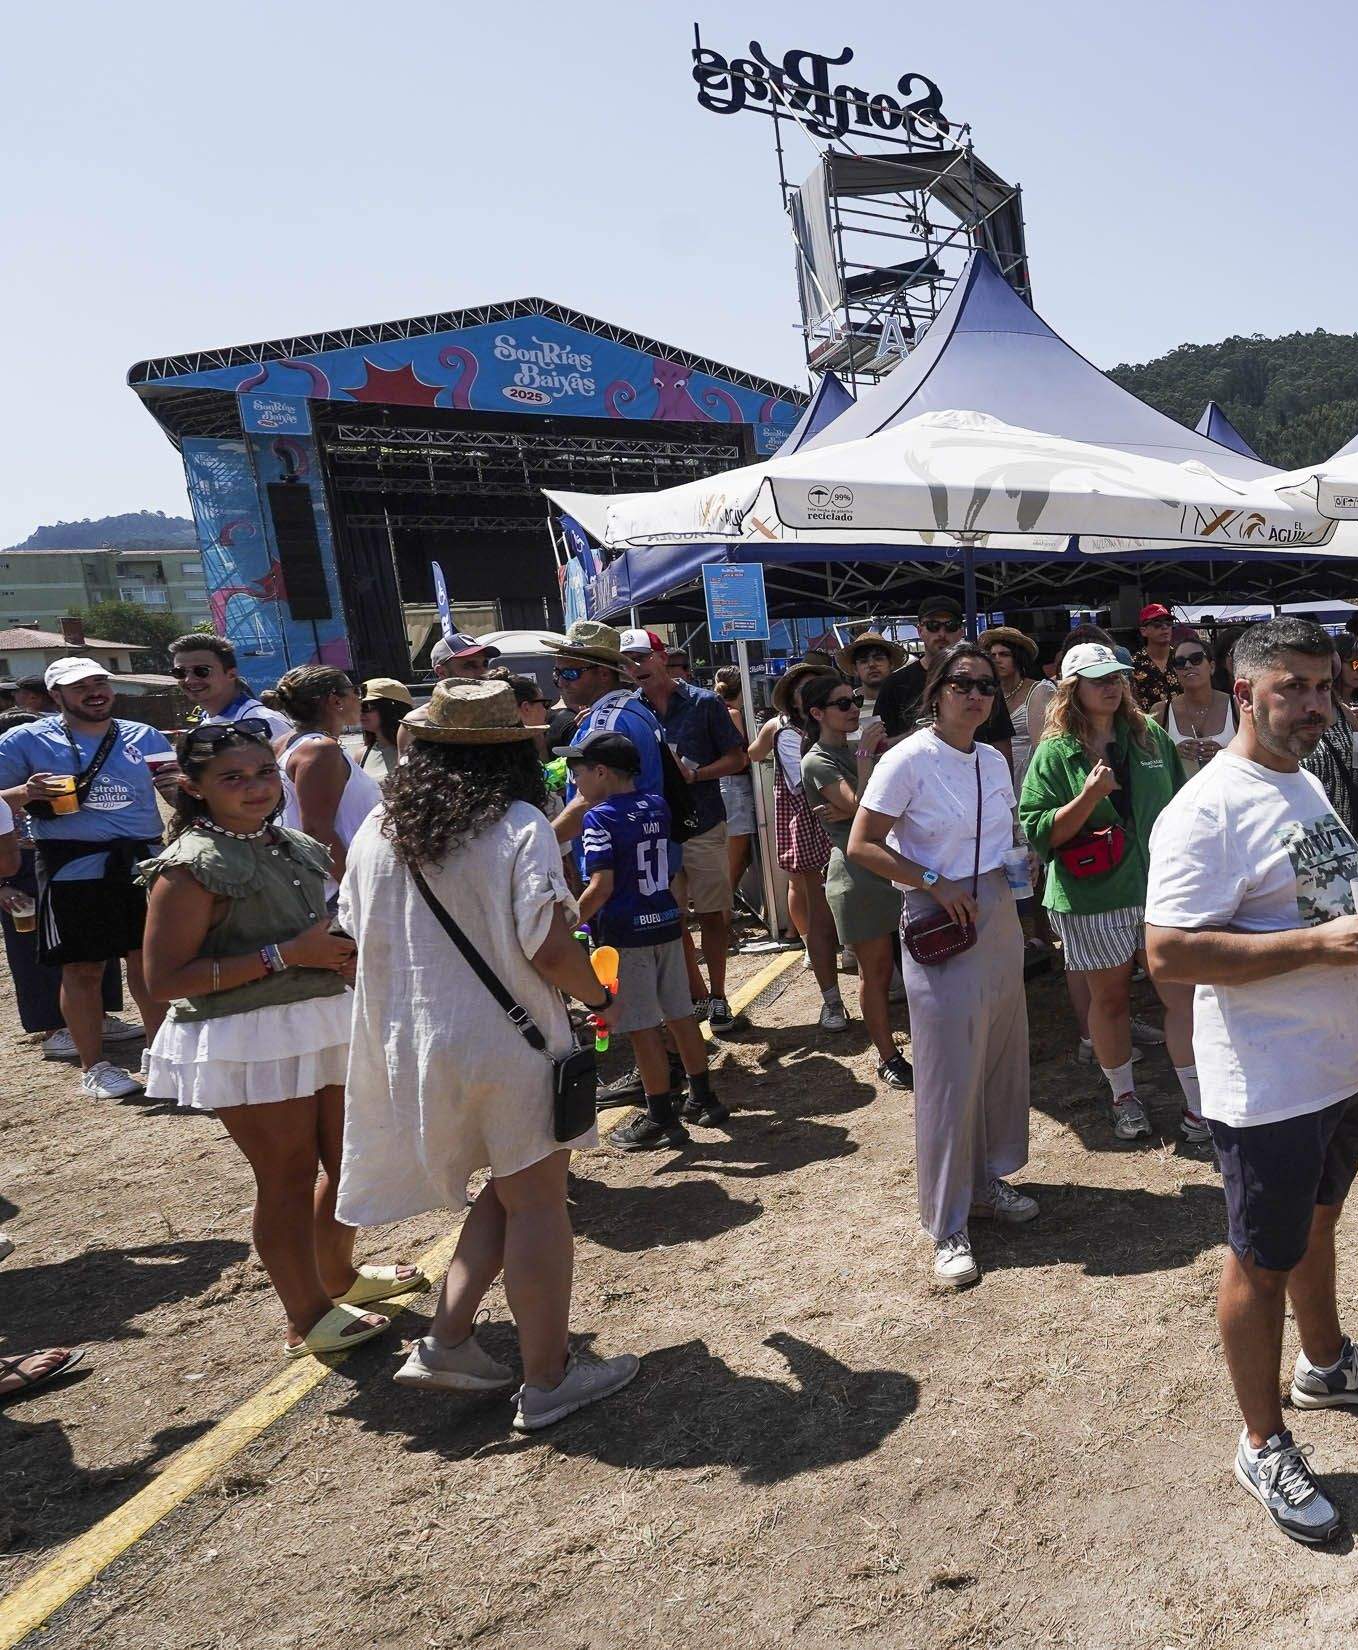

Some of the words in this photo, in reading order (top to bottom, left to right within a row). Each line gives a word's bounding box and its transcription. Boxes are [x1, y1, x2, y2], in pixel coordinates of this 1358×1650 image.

[494, 334, 593, 372] SonRías
[514, 362, 596, 397] Baixas
[509, 388, 543, 402] 2025
[834, 493, 851, 501] 99%
[807, 512, 853, 521] reciclado
[1294, 521, 1304, 531] EL
[637, 838, 669, 896] 51
